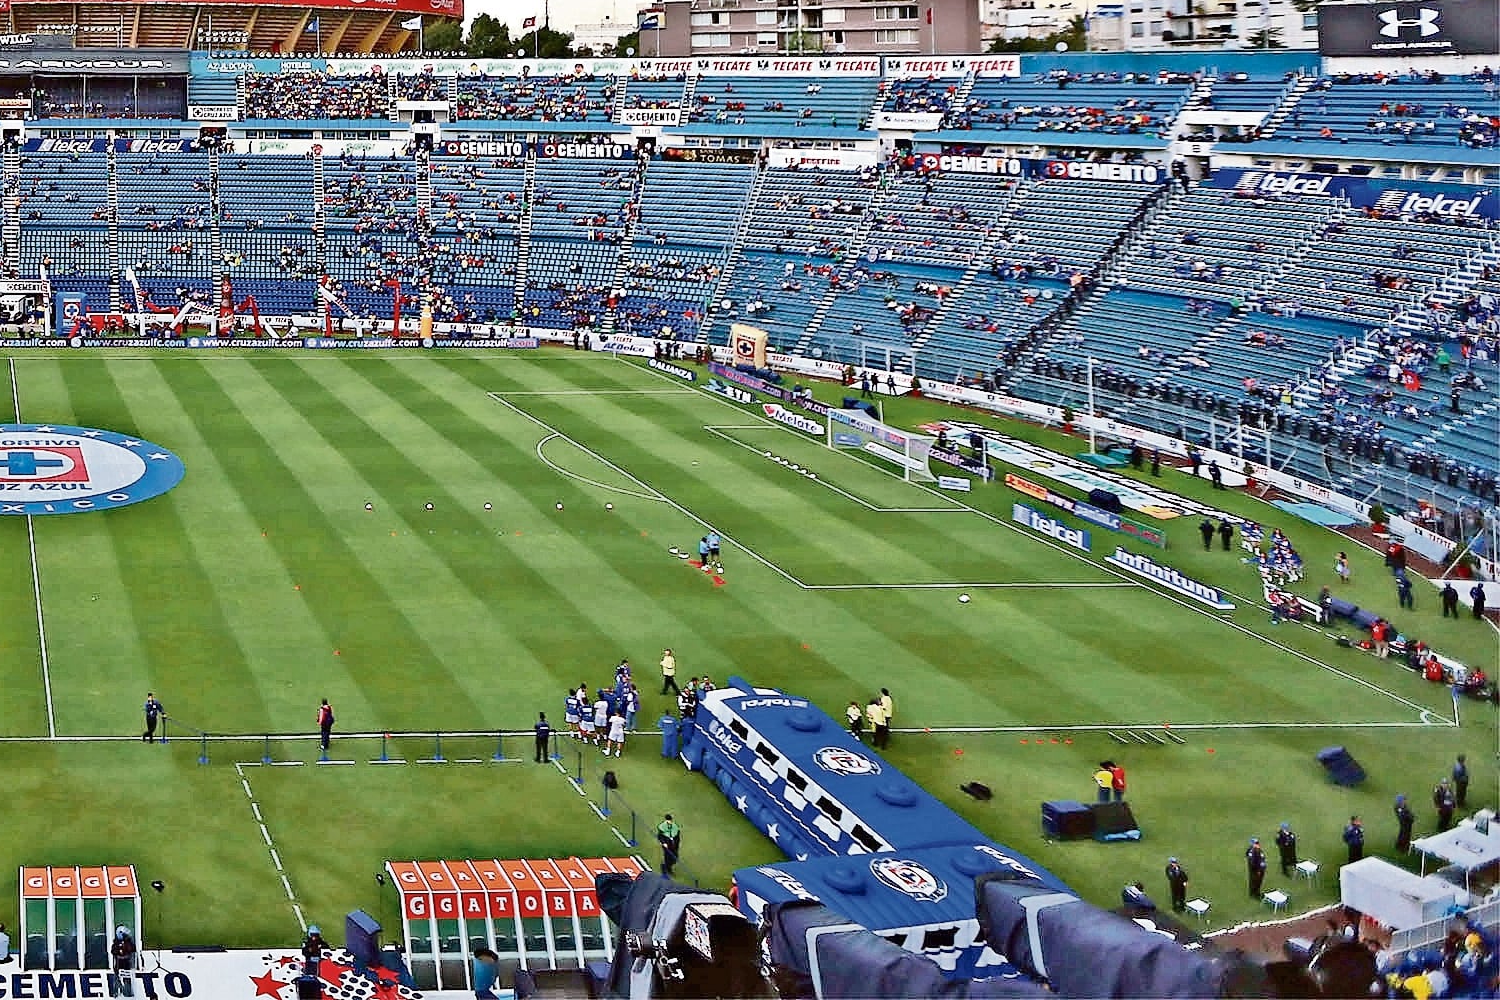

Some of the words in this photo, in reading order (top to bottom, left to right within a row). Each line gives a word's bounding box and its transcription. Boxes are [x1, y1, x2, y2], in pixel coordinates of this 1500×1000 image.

[0, 34, 33, 46] WILL
[654, 61, 692, 72] TECATE
[713, 61, 751, 72] TECATE
[773, 62, 813, 72] TECATE
[836, 61, 877, 72] TECATE
[905, 61, 948, 72] TECATE
[971, 59, 1016, 71] TECATE
[636, 112, 676, 122] CEMENTO
[52, 140, 93, 152] telcel
[142, 140, 184, 152] telcel
[460, 142, 522, 155] CEMENTO
[557, 143, 622, 158] CEMENTO
[940, 155, 1021, 174] CEMENTO
[1068, 162, 1157, 182] CEMENTO
[1260, 173, 1332, 197] telcel
[1404, 192, 1482, 217] telcel
[83, 339, 185, 348] www.cruzazulfc.com
[203, 339, 303, 348] www.cruzazulfc.com
[319, 339, 419, 348] www.cruzazulfc.com
[655, 361, 694, 380] ALIANZA
[726, 384, 753, 403] ETN
[775, 410, 818, 432] Melate
[28, 483, 93, 491] AZUL
[1031, 512, 1084, 549] telcel
[1115, 546, 1220, 604] infinitum
[27, 876, 43, 888] G
[56, 876, 72, 888] G
[84, 876, 100, 888] G
[112, 876, 128, 888] G
[400, 870, 420, 883] G
[409, 896, 426, 916] G
